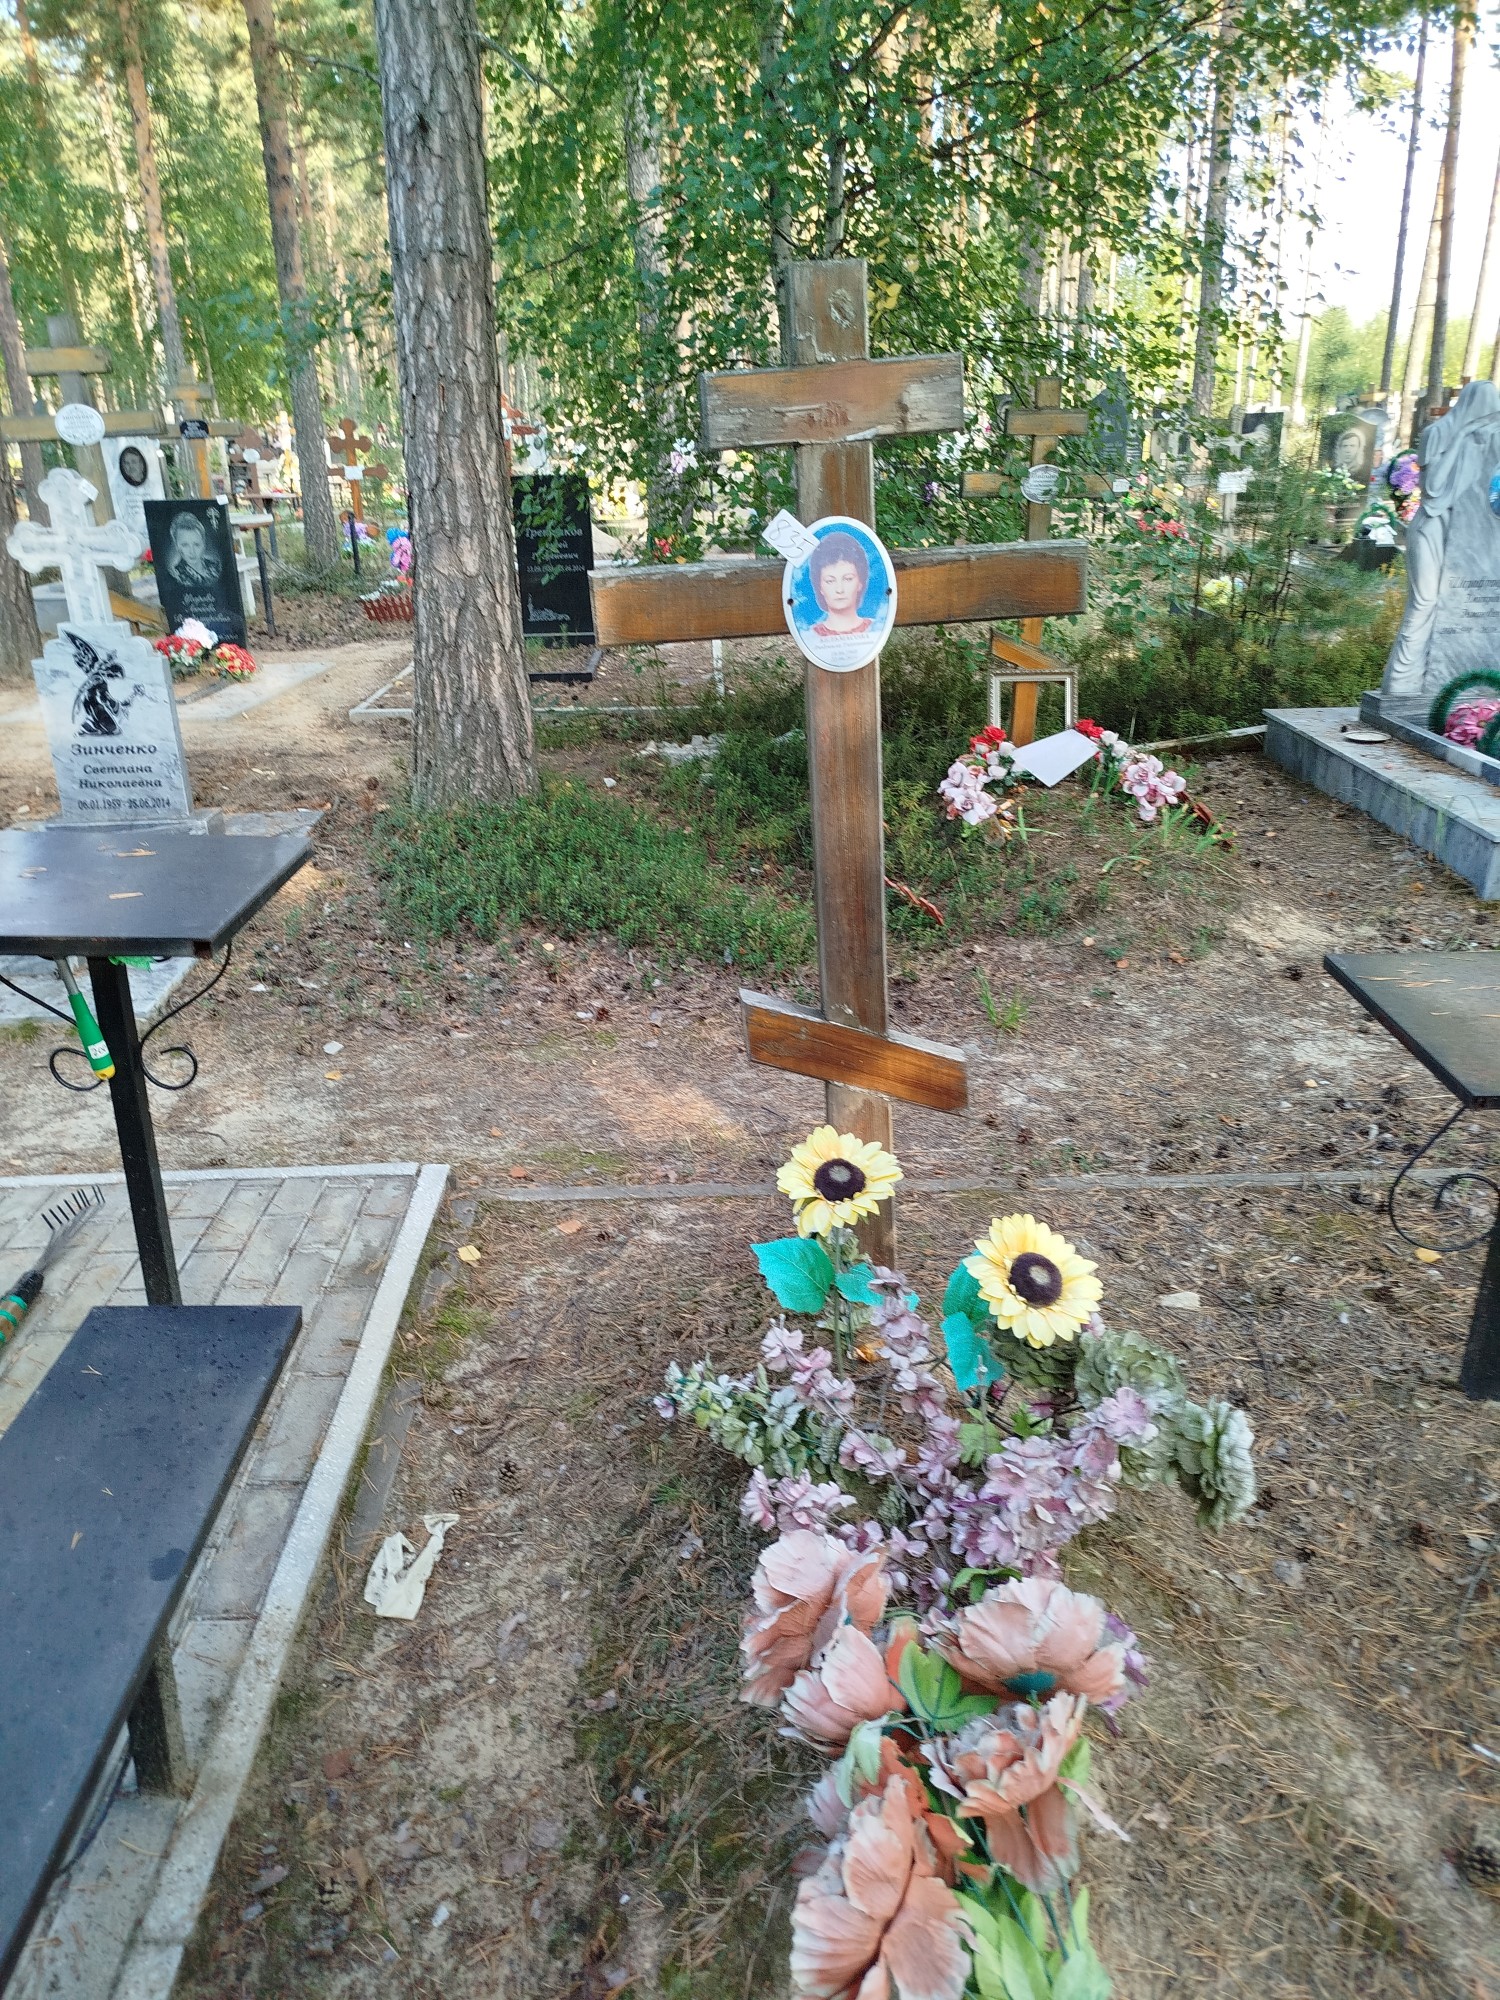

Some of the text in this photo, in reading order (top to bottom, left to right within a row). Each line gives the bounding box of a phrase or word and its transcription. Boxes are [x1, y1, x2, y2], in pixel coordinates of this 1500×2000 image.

[70, 743, 158, 756] Зинченко
[83, 764, 153, 775] Светлана
[79, 778, 163, 789] Николаевна
